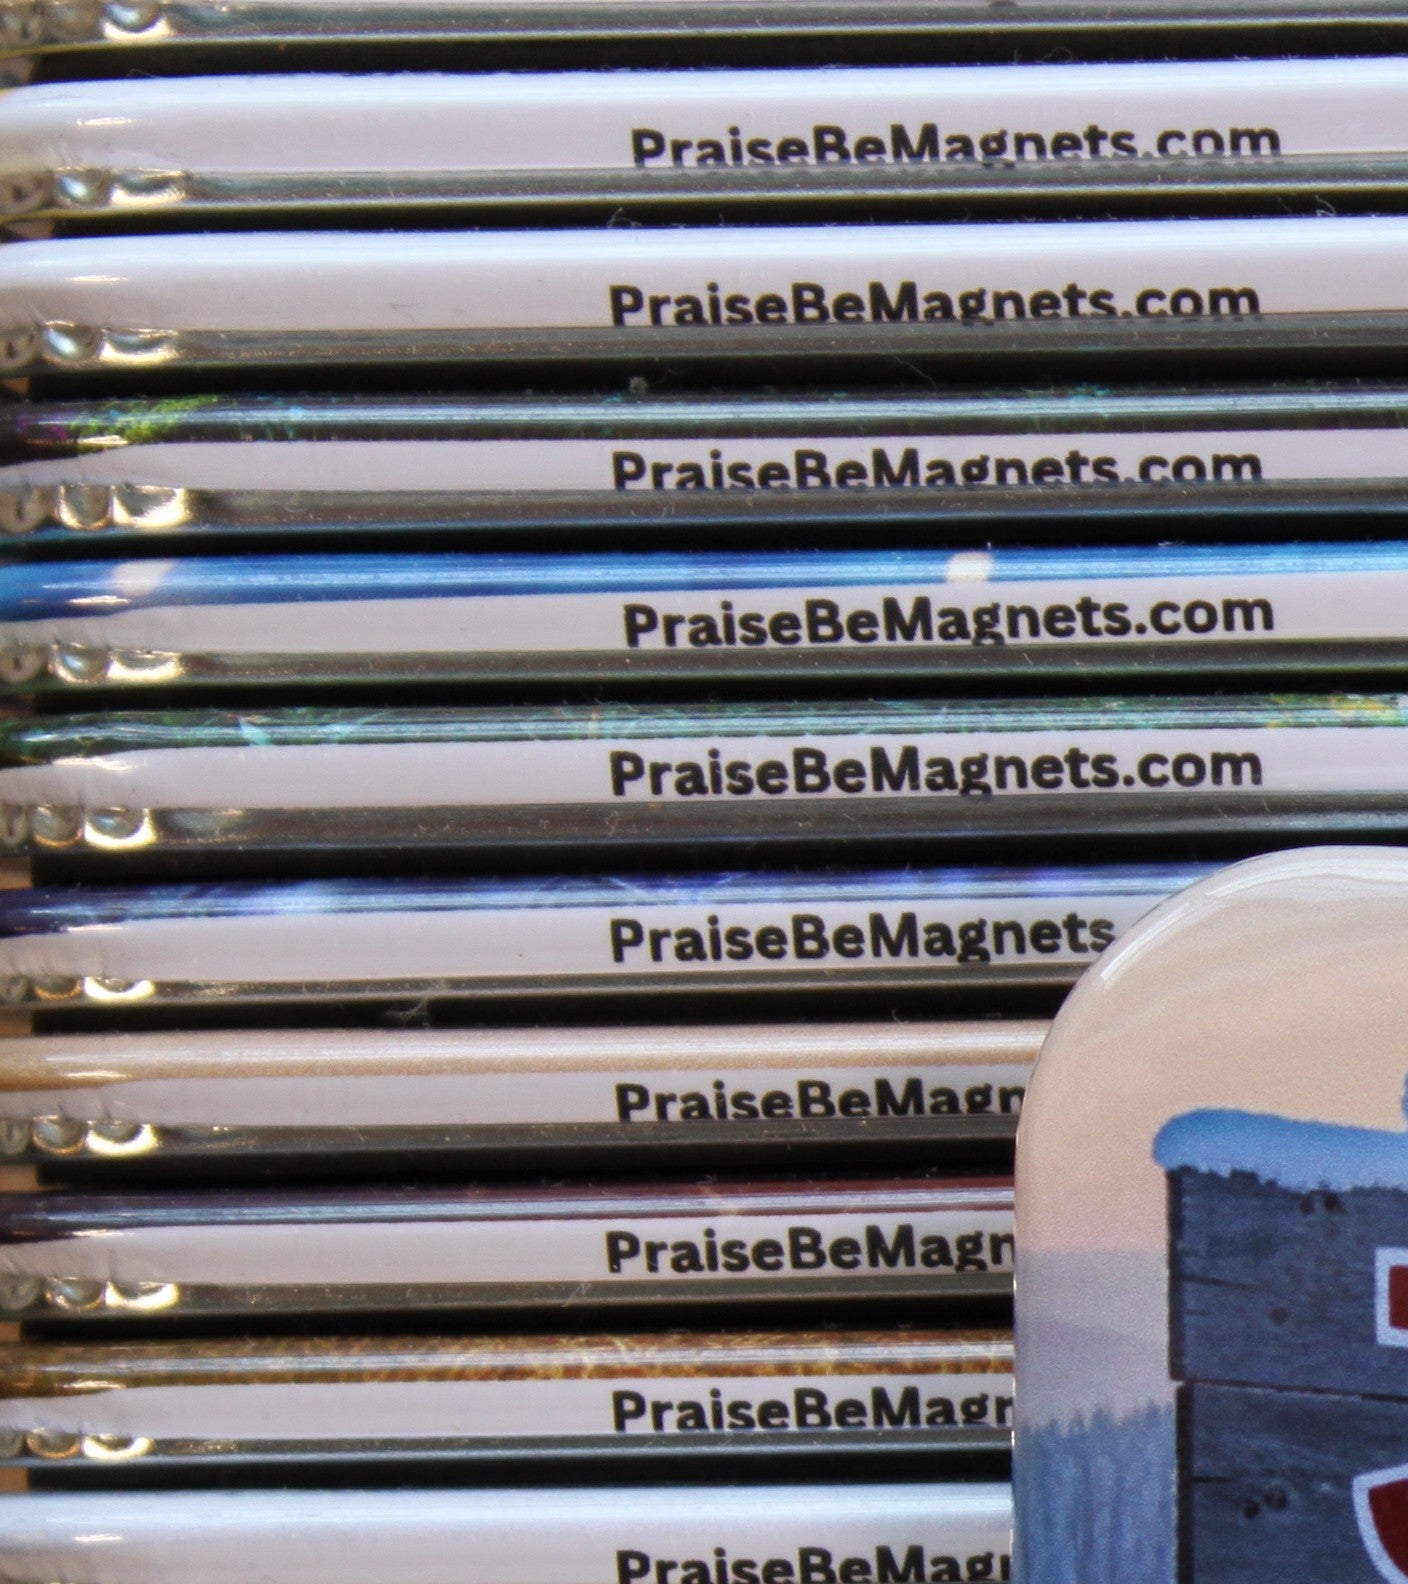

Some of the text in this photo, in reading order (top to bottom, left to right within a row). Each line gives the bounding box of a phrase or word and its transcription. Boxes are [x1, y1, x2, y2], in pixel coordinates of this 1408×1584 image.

[610, 282, 1260, 326] PraiseBeMagnets.com
[623, 596, 1275, 648] PraiseBeMagnets.com
[610, 746, 1263, 797] PraiseBeMagnets.com
[610, 912, 1116, 963] PraiseBeMagnets
[615, 1078, 1026, 1121] PraiseBeMagn
[606, 1224, 1014, 1273] PraiseBeMagn
